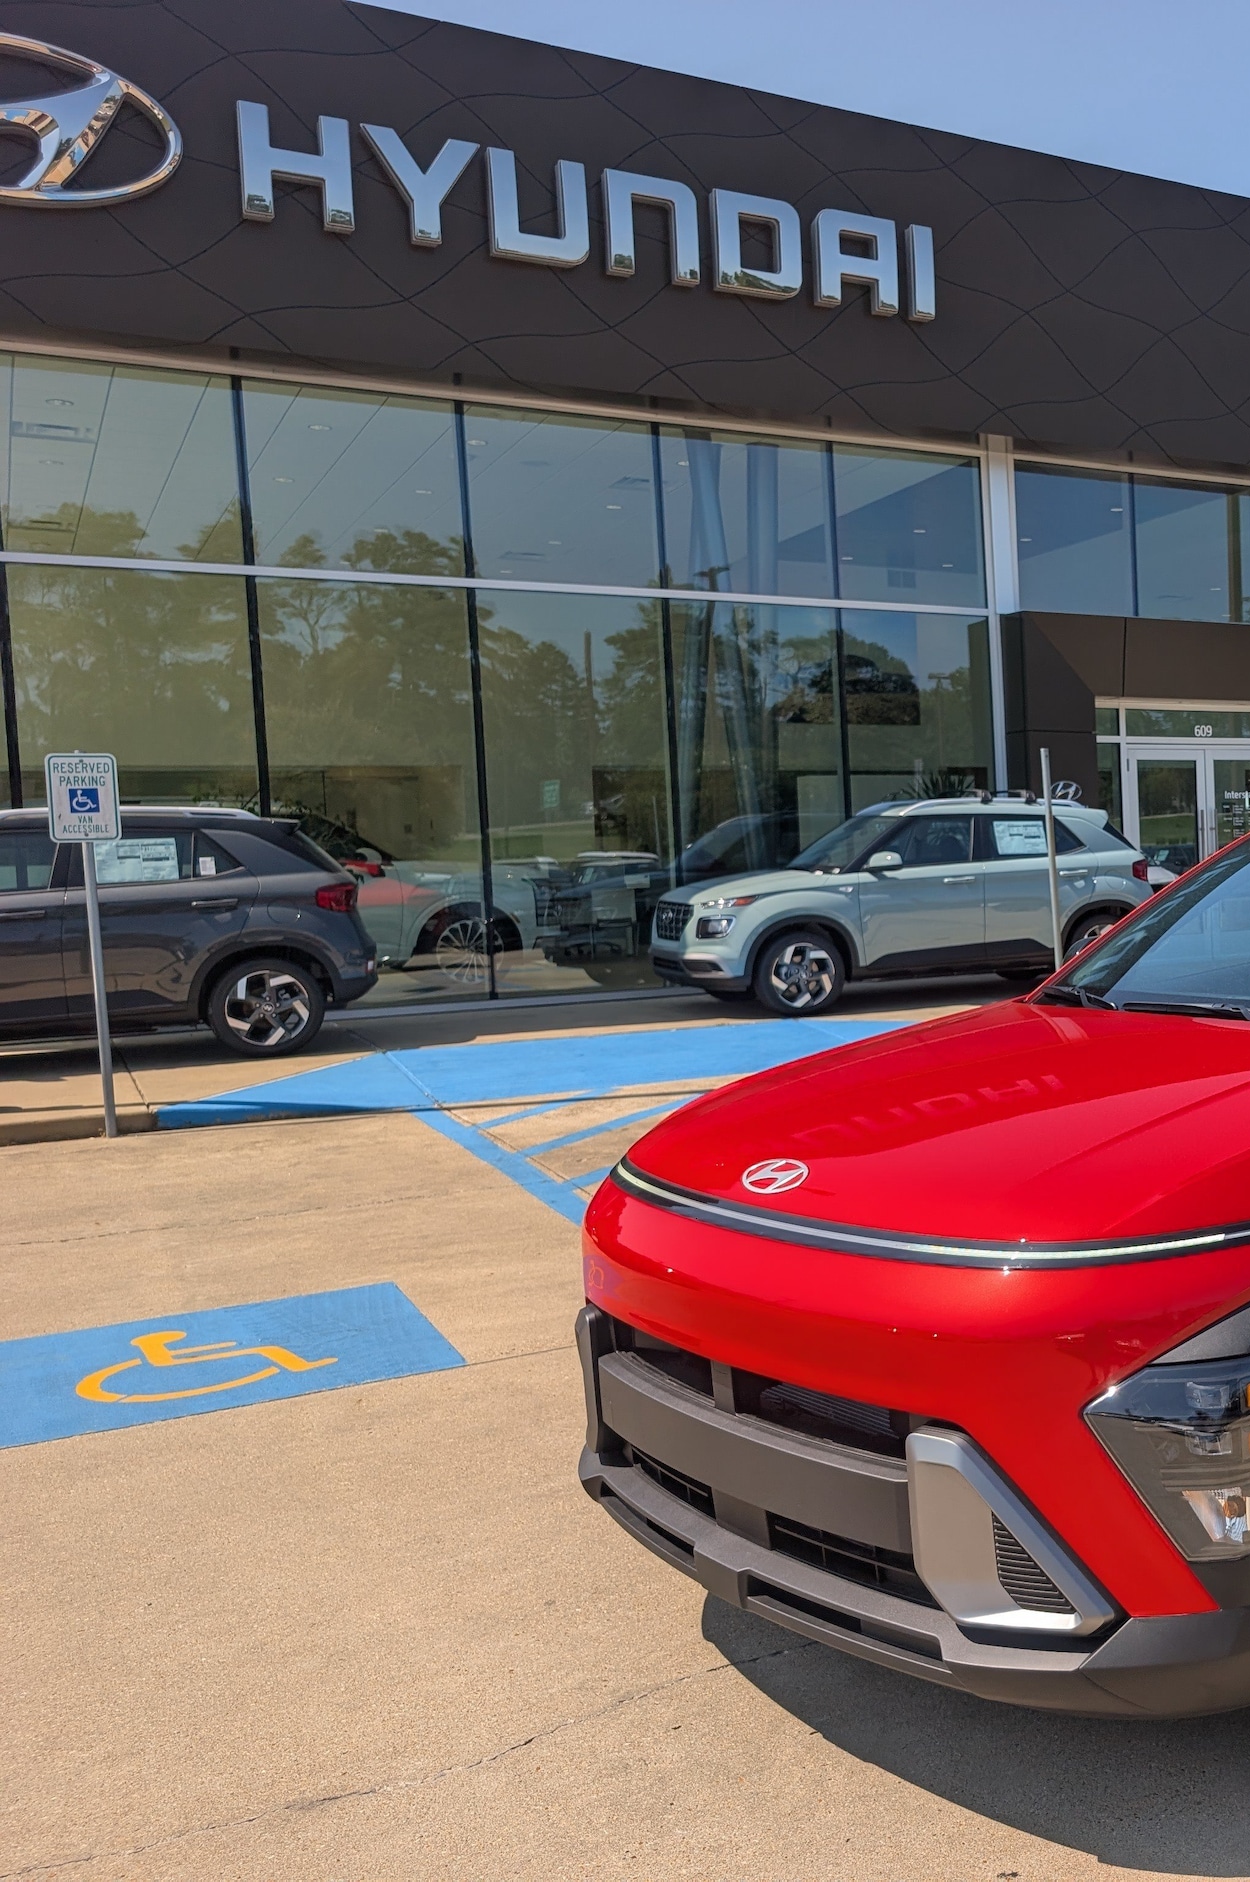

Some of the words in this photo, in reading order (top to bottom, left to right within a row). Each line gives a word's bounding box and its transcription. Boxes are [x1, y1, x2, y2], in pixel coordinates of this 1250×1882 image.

[237, 100, 937, 322] HYUNDAI
[1194, 724, 1213, 737] 609
[52, 762, 110, 774] RESERVED
[59, 776, 106, 787] PARKING
[77, 815, 93, 824] VAN
[62, 824, 109, 834] ACCESSIBLE
